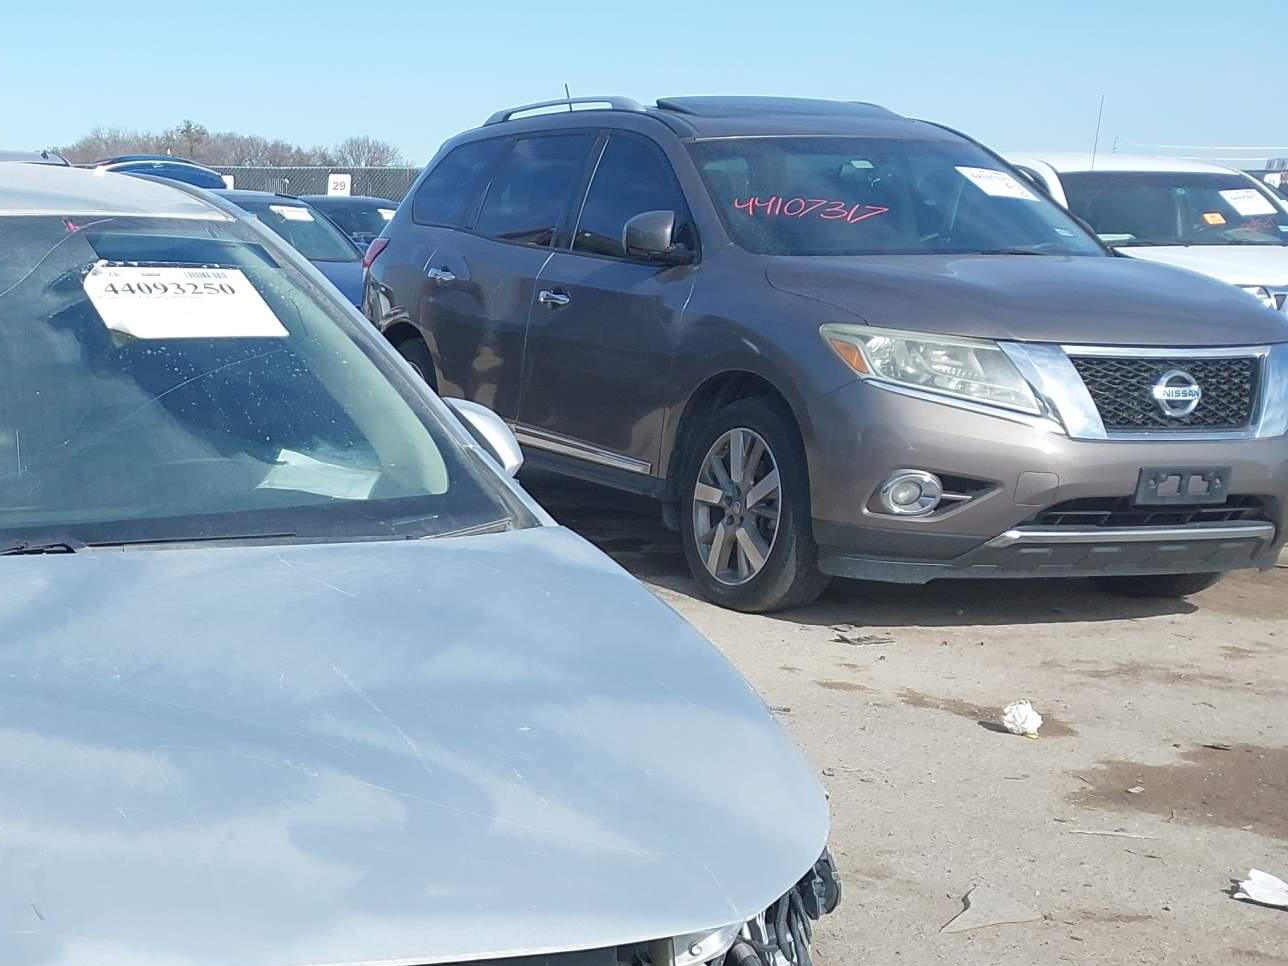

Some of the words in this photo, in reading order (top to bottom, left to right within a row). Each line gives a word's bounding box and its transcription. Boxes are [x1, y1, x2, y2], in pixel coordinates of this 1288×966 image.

[332, 181, 346, 191] 29
[733, 196, 889, 224] 44107317
[104, 282, 236, 295] 44093250
[1163, 389, 1199, 398] NISSAN
